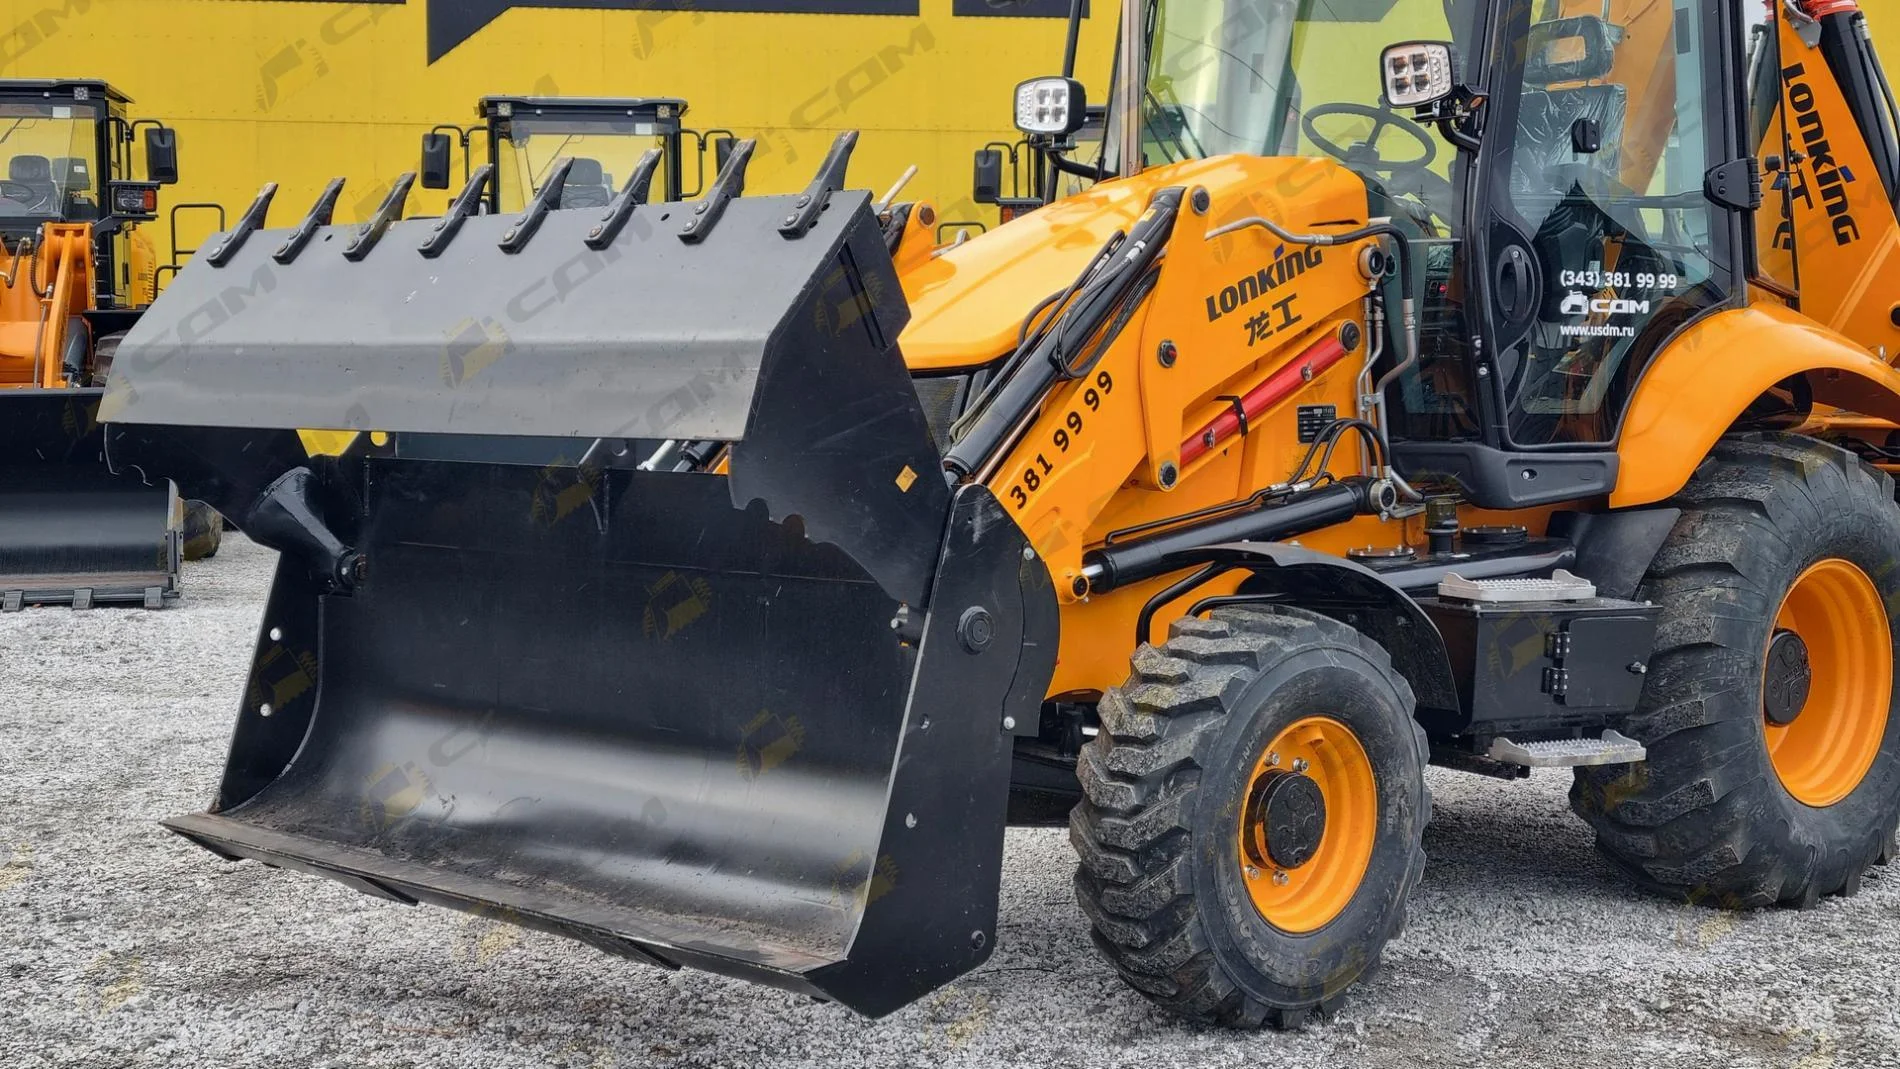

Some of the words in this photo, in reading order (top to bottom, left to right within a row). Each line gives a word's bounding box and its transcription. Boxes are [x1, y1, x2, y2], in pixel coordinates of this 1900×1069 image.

[1782, 62, 1861, 247] LONKING
[1205, 243, 1323, 322] LONKING
[1560, 269, 1600, 287] (343)
[1604, 271, 1631, 288] 381
[1636, 272, 1655, 289] 99
[1658, 273, 1677, 289] 99
[1244, 293, 1302, 347] 龙工
[1560, 323, 1635, 337] www.usdm.ru
[1010, 453, 1054, 510] 381
[1053, 411, 1083, 454] 99
[1083, 370, 1113, 413] 99
